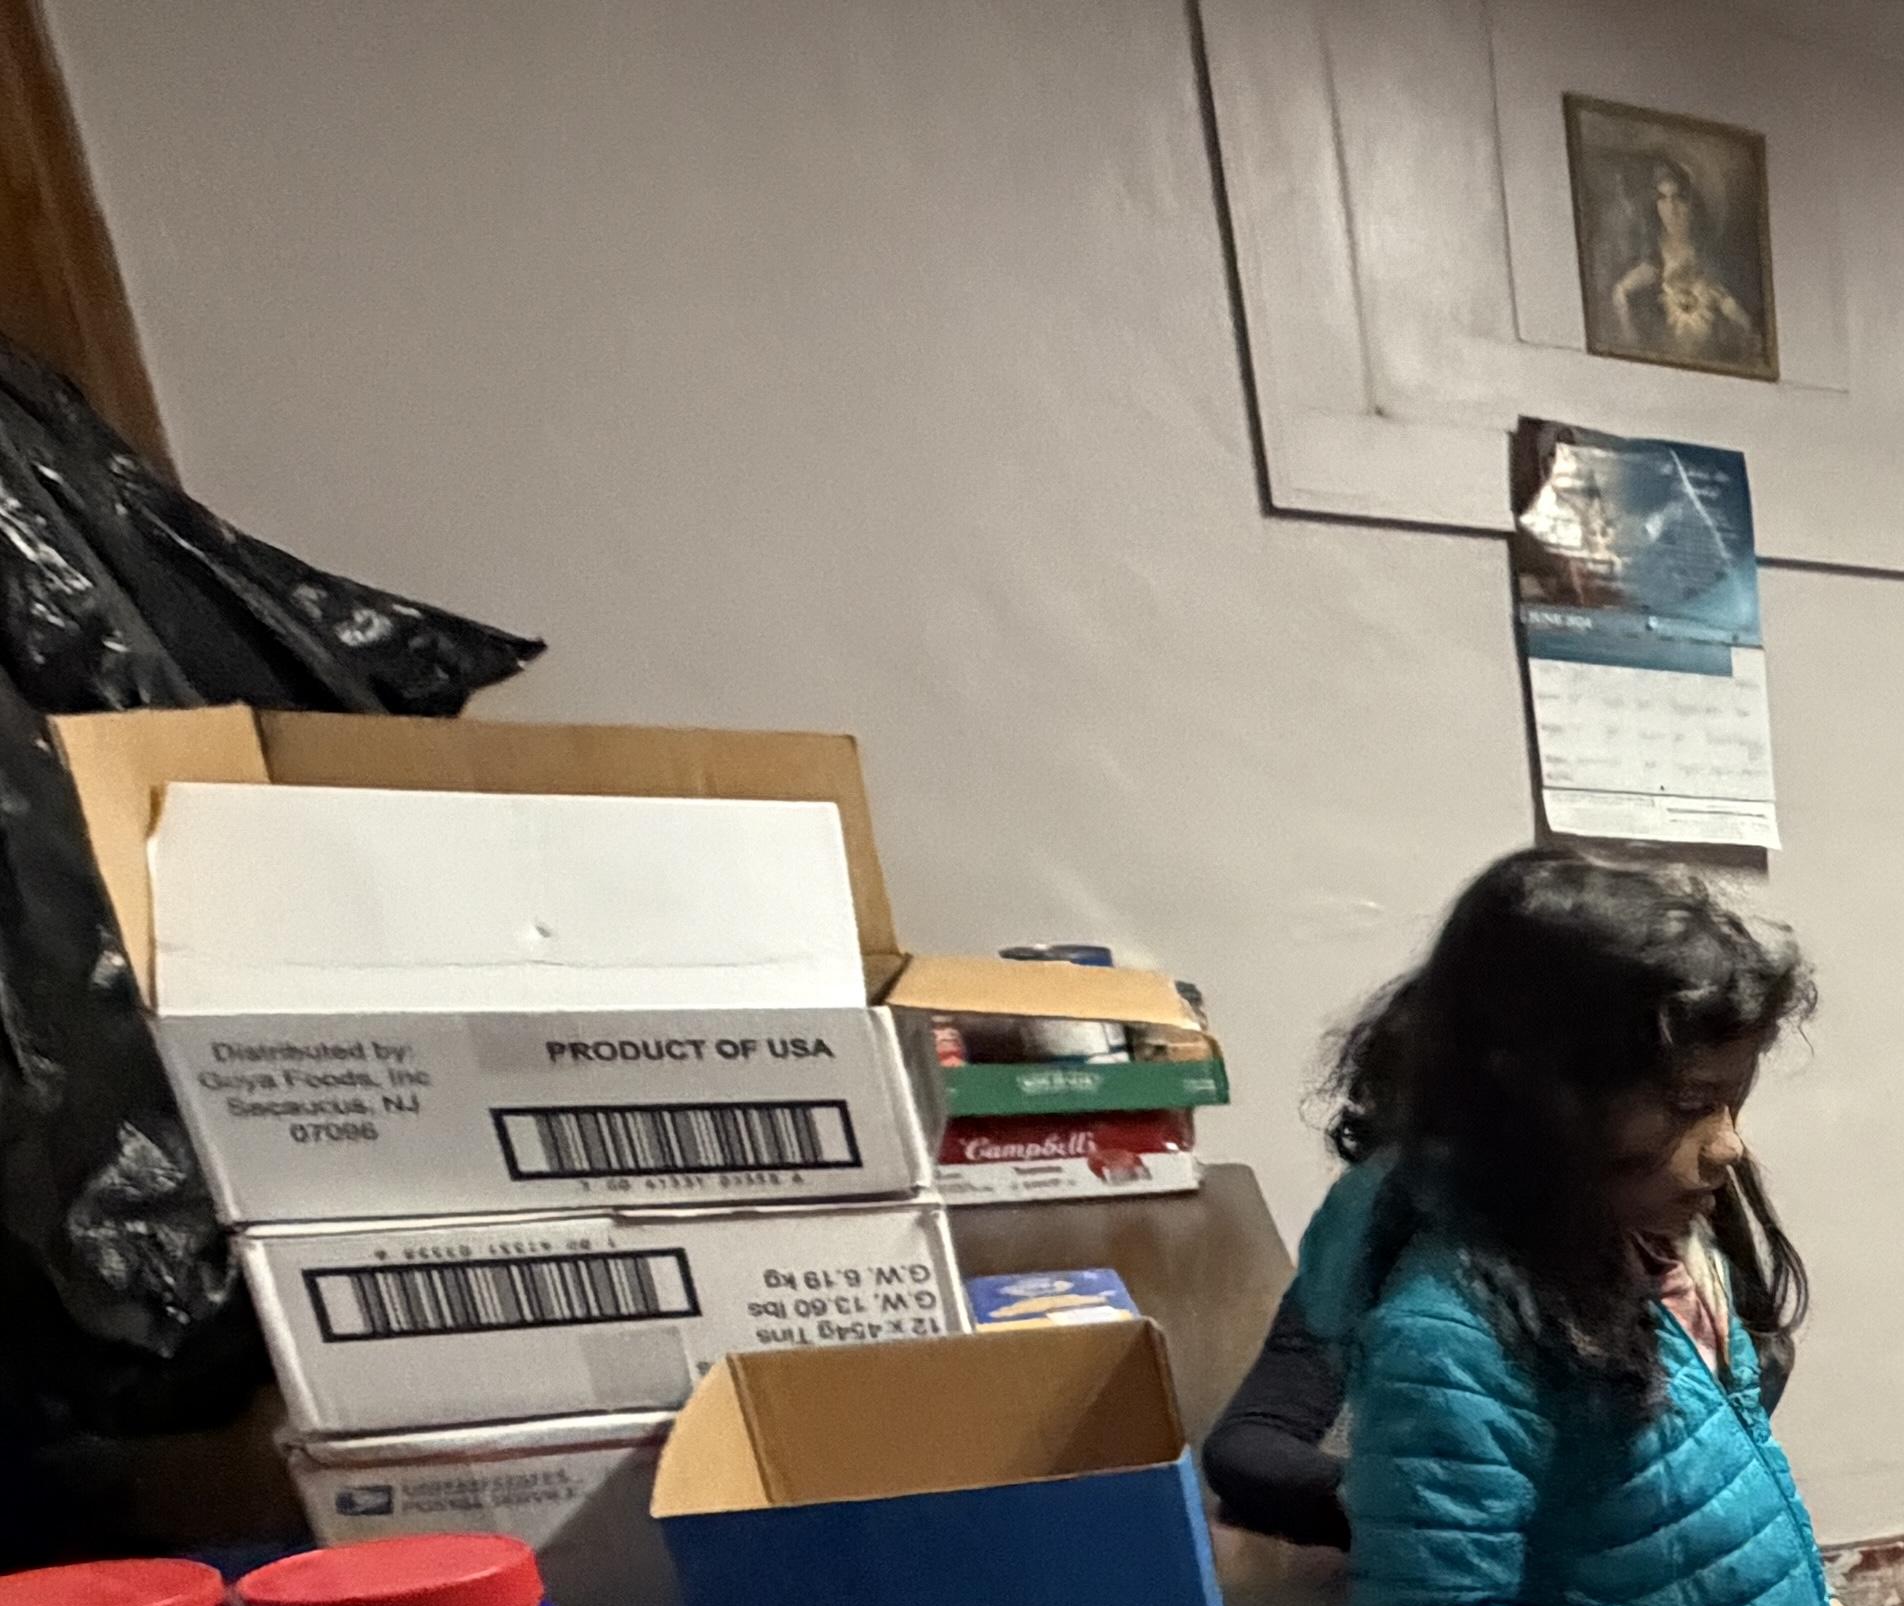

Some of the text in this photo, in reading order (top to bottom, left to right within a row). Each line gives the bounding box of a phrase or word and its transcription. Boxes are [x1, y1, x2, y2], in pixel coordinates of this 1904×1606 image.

[545, 1038, 835, 1063] PRODUCT OF USA
[381, 1093, 420, 1115] NJ
[290, 1121, 379, 1143] 07096
[762, 1268, 798, 1291] kg
[747, 1300, 788, 1320] lbs
[755, 1325, 814, 1345] Tins
[816, 1319, 883, 1341] 454g
